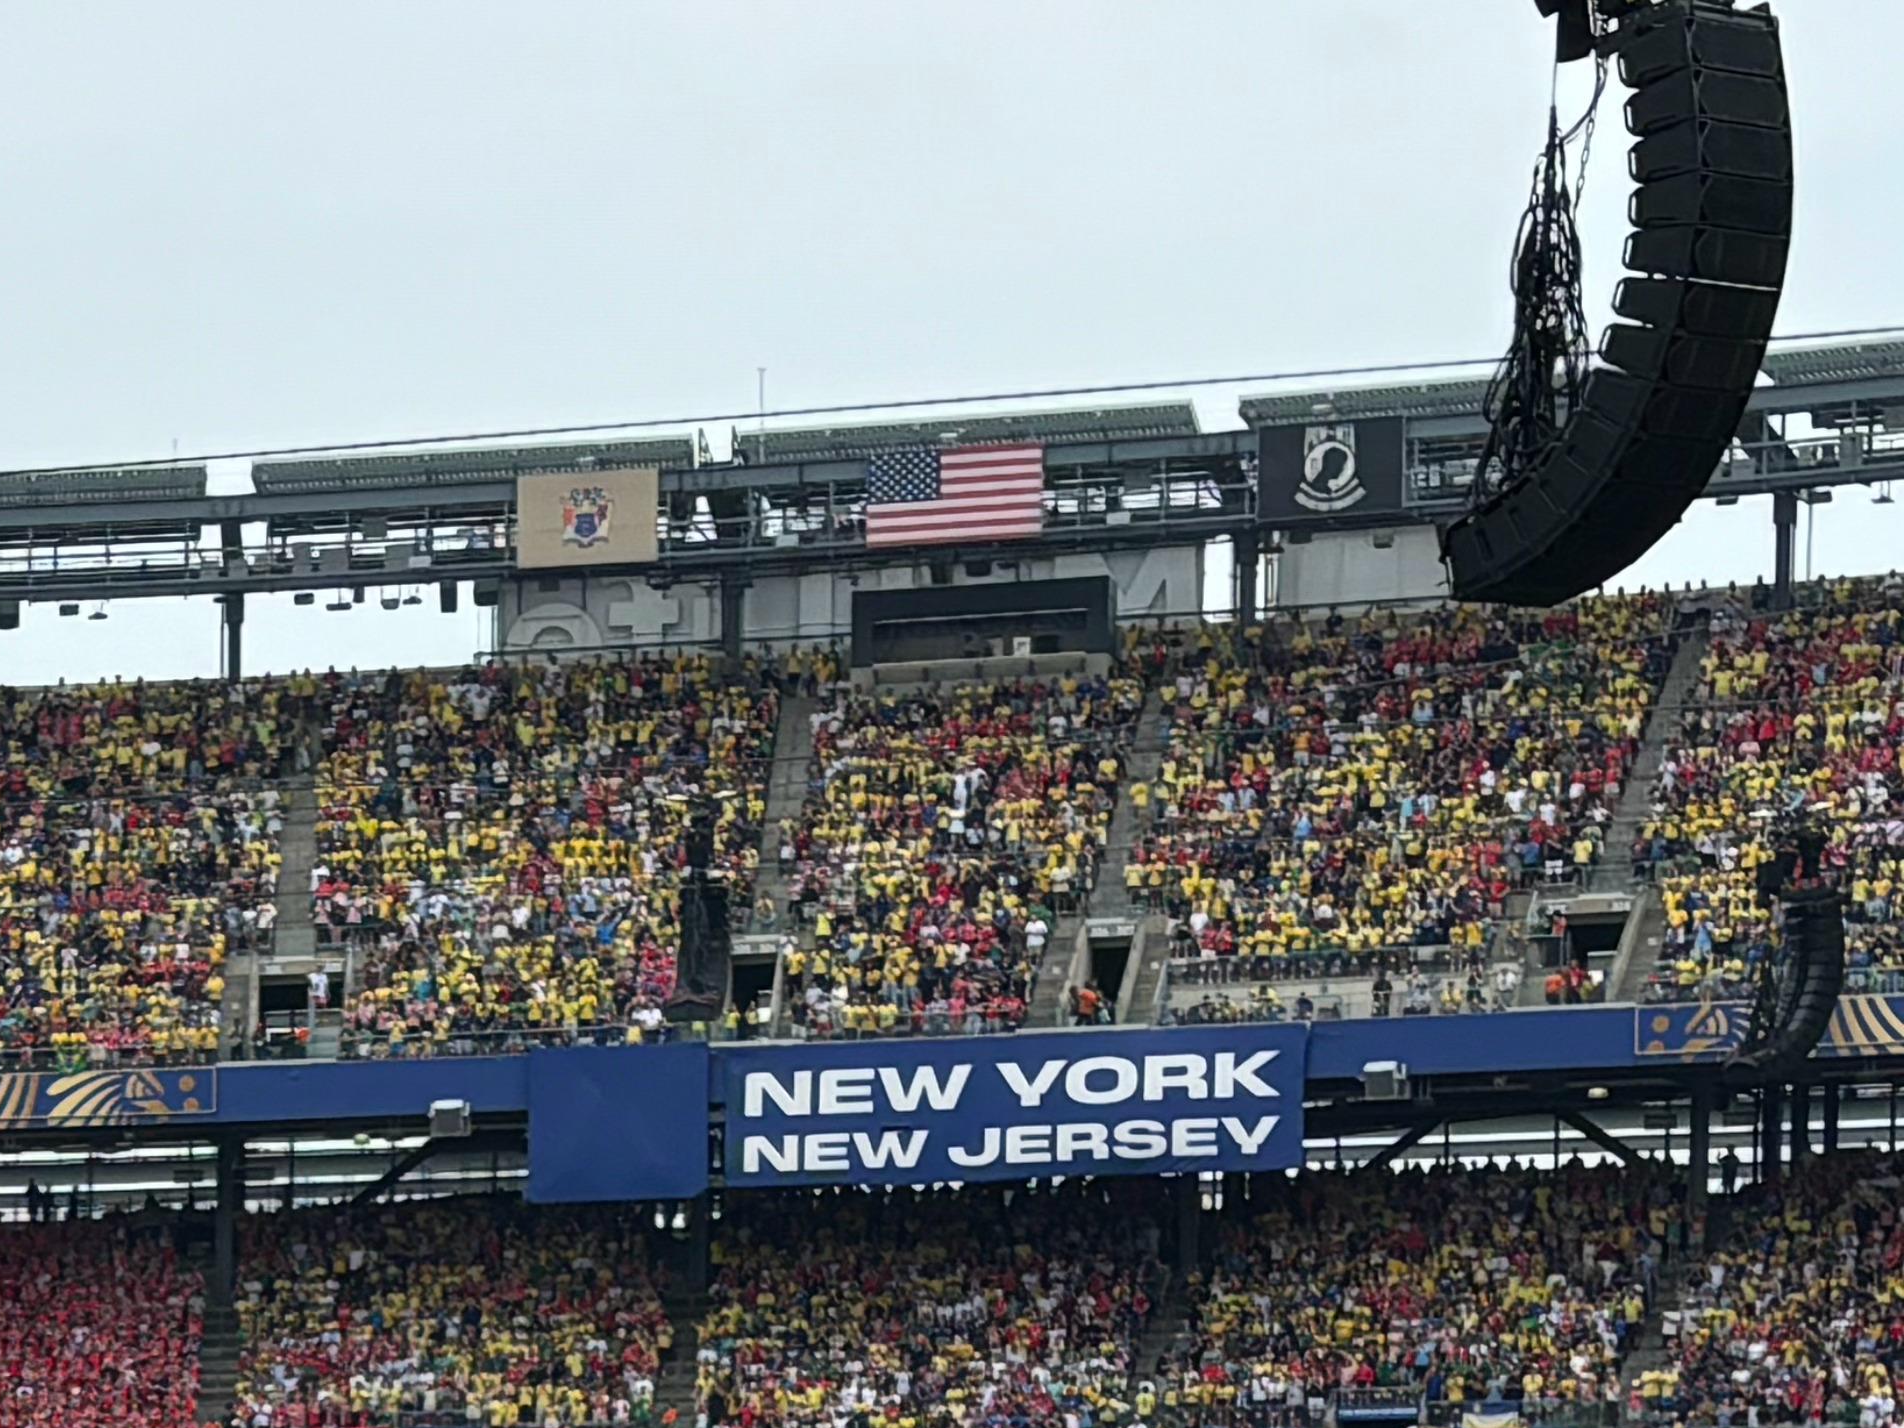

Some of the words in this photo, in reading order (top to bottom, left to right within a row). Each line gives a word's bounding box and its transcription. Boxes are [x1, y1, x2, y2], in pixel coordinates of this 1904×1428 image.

[744, 1063, 973, 1117] NEW
[995, 1050, 1281, 1107] YORK
[743, 1129, 929, 1173] NEW
[948, 1115, 1281, 1168] JERSEY
